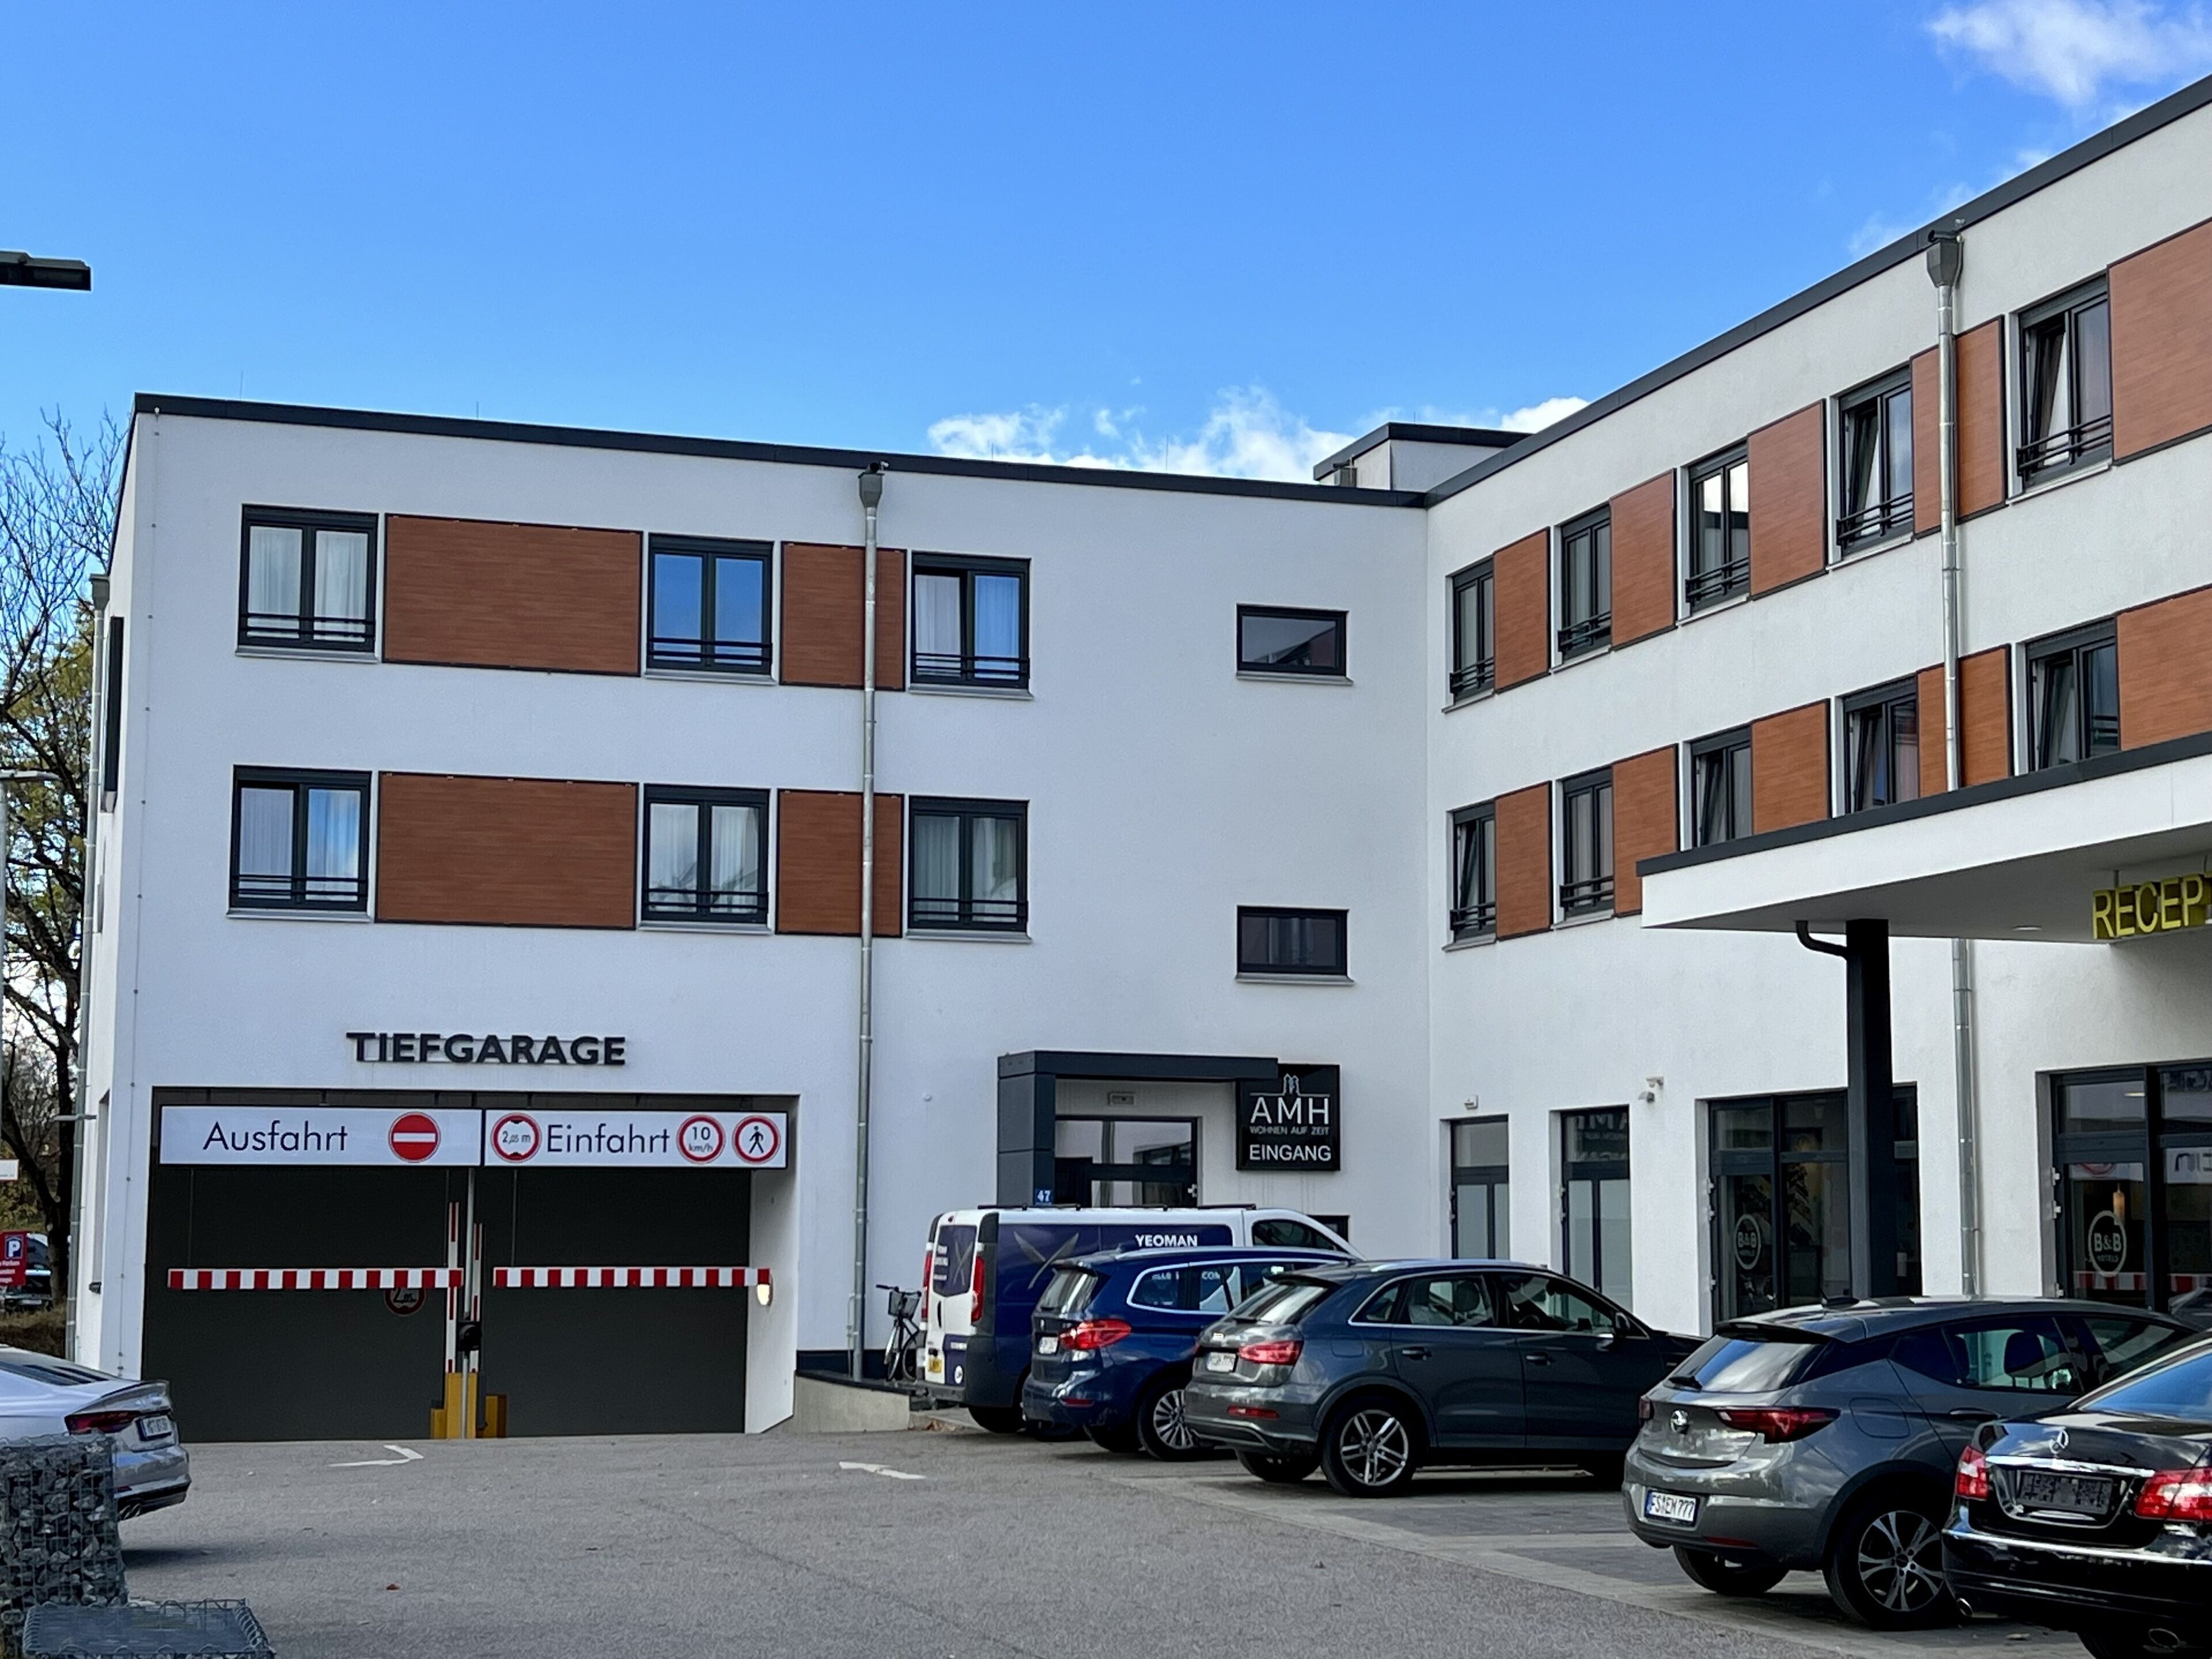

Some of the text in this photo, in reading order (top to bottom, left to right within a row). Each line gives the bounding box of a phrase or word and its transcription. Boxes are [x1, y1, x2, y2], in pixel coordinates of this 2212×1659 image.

[346, 1032, 626, 1065] TIEFGARAGE
[1250, 1096, 1329, 1124] AMH
[203, 1120, 348, 1151] Ausfahrt
[548, 1123, 670, 1153] Einfahrt
[692, 1126, 711, 1141] 10
[1250, 1126, 1330, 1136] WOHNEN AUF ZEIT
[688, 1143, 713, 1153] km/h
[1249, 1144, 1332, 1161] EINGANG
[1037, 1190, 1051, 1202] 47
[8, 1240, 21, 1257] P
[1135, 1234, 1198, 1248] YEOMAN
[2094, 1233, 2122, 1252] B&B
